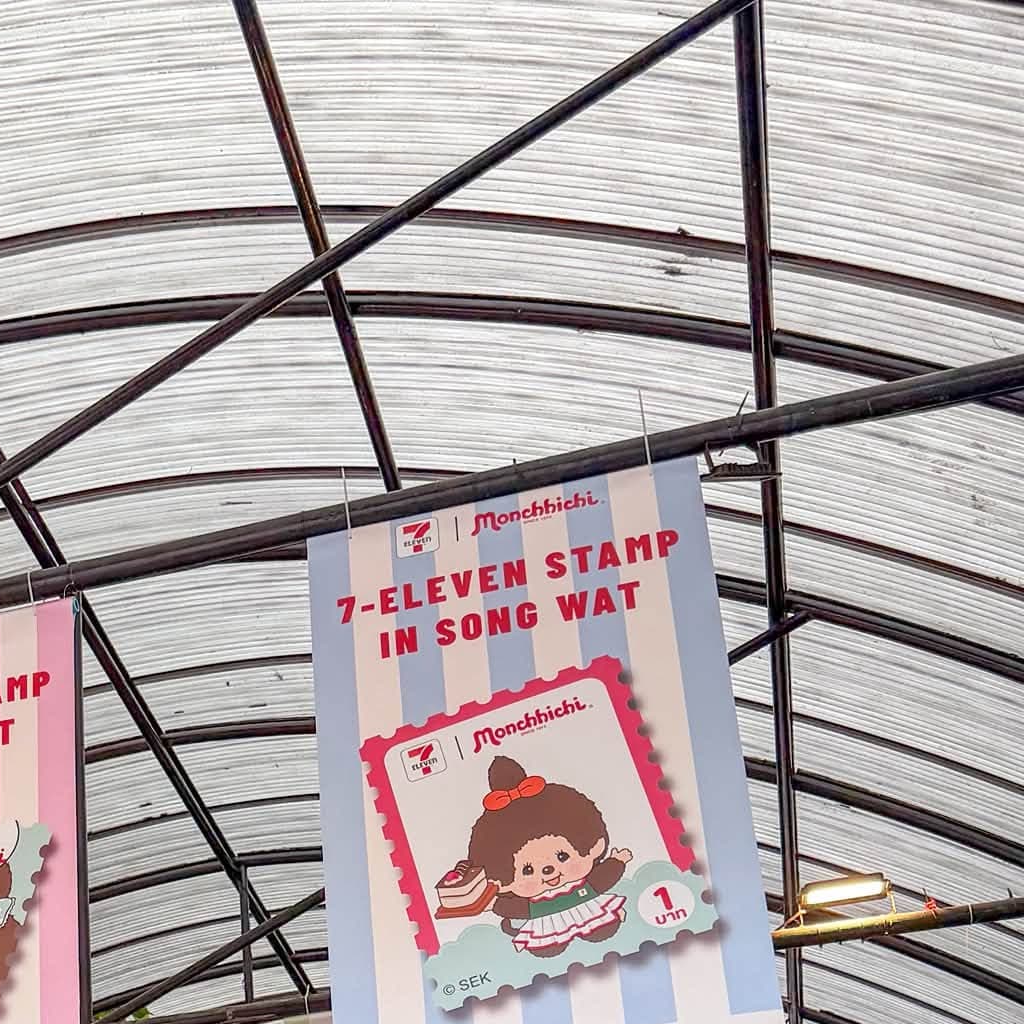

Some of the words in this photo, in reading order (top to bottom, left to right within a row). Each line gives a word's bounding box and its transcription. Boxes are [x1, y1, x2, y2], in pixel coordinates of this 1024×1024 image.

[472, 491, 598, 536] Monchhichi
[337, 559, 527, 624] 7-ELEVEN
[545, 530, 678, 578] STAMP
[380, 626, 417, 658] IN
[436, 602, 537, 645] SONG
[556, 581, 640, 621] WAT
[472, 696, 587, 754] Monchhichi
[653, 886, 673, 912] 1
[655, 907, 687, 926] บาท
[458, 971, 492, 993] SEK
